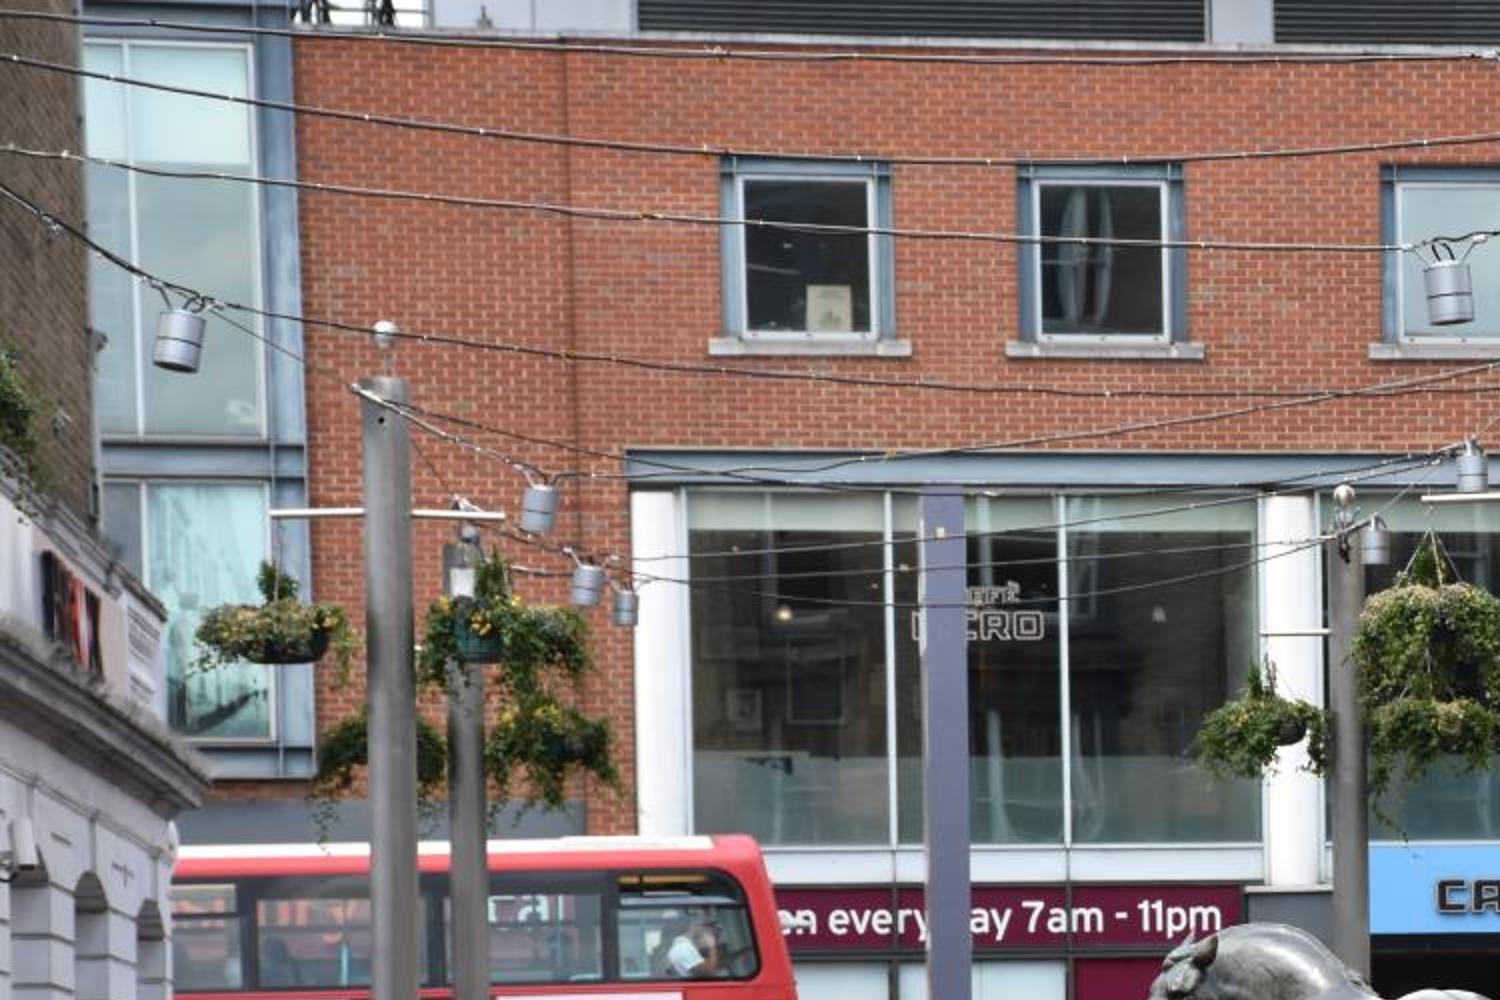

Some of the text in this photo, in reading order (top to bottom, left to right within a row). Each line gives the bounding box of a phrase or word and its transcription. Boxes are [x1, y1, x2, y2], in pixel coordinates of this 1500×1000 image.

[777, 909, 817, 935] en
[828, 908, 929, 941] every
[970, 908, 1013, 941] ay
[1021, 900, 1104, 933] 7am
[1137, 899, 1221, 939] 11pm
